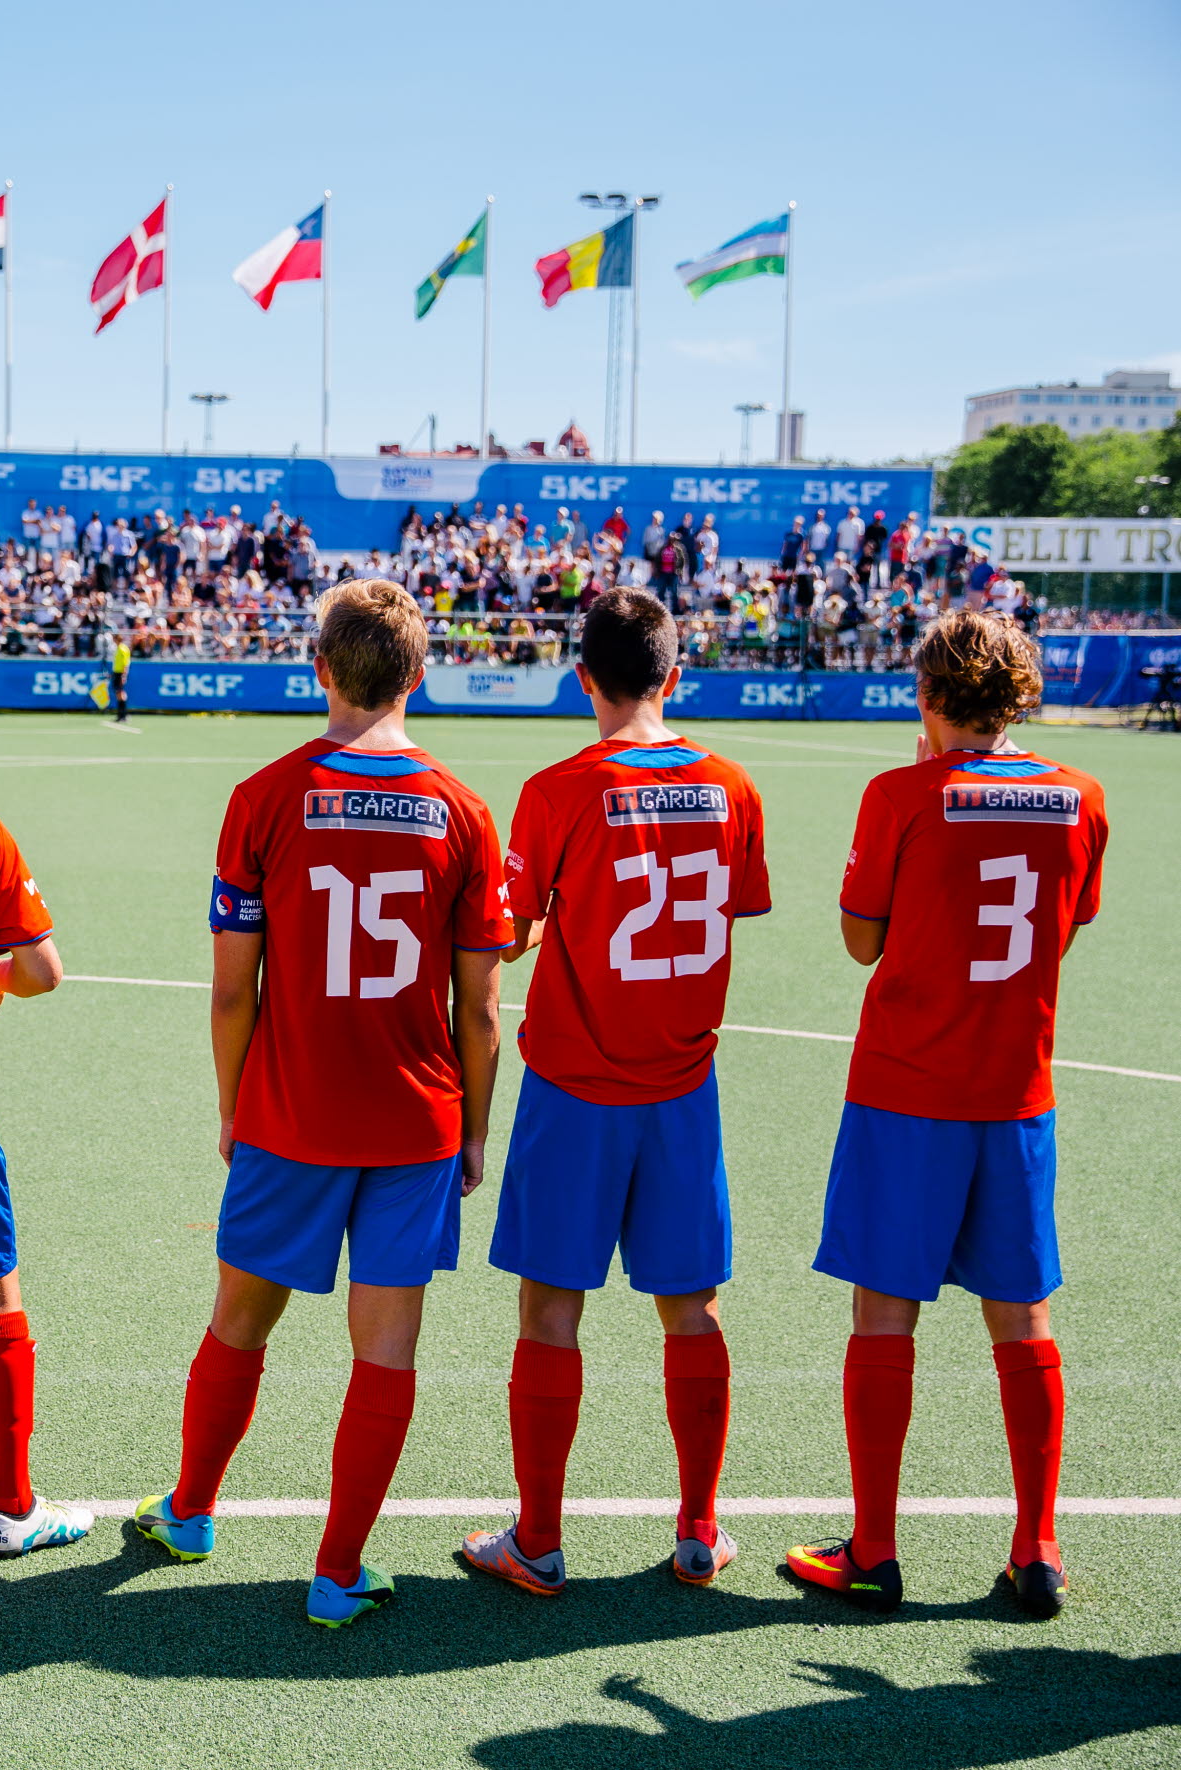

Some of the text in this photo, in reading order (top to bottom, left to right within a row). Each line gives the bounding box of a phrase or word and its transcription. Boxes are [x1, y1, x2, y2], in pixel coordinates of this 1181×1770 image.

[60, 465, 151, 492] SKF
[194, 467, 285, 493] SKF
[540, 475, 628, 501] SKF
[671, 477, 760, 503] SKF
[801, 480, 889, 505] SKF
[1002, 528, 1099, 562] ELIT
[1117, 528, 1181, 563] TR
[159, 673, 244, 698] SKF
[862, 684, 916, 707] SK
[311, 793, 444, 825] IT GÅRDEN
[608, 786, 724, 813] IT GÅRDEN
[946, 786, 1076, 811] IT GÅRDEN
[609, 849, 730, 981] 23
[969, 854, 1039, 982] 3
[308, 864, 424, 999] 15
